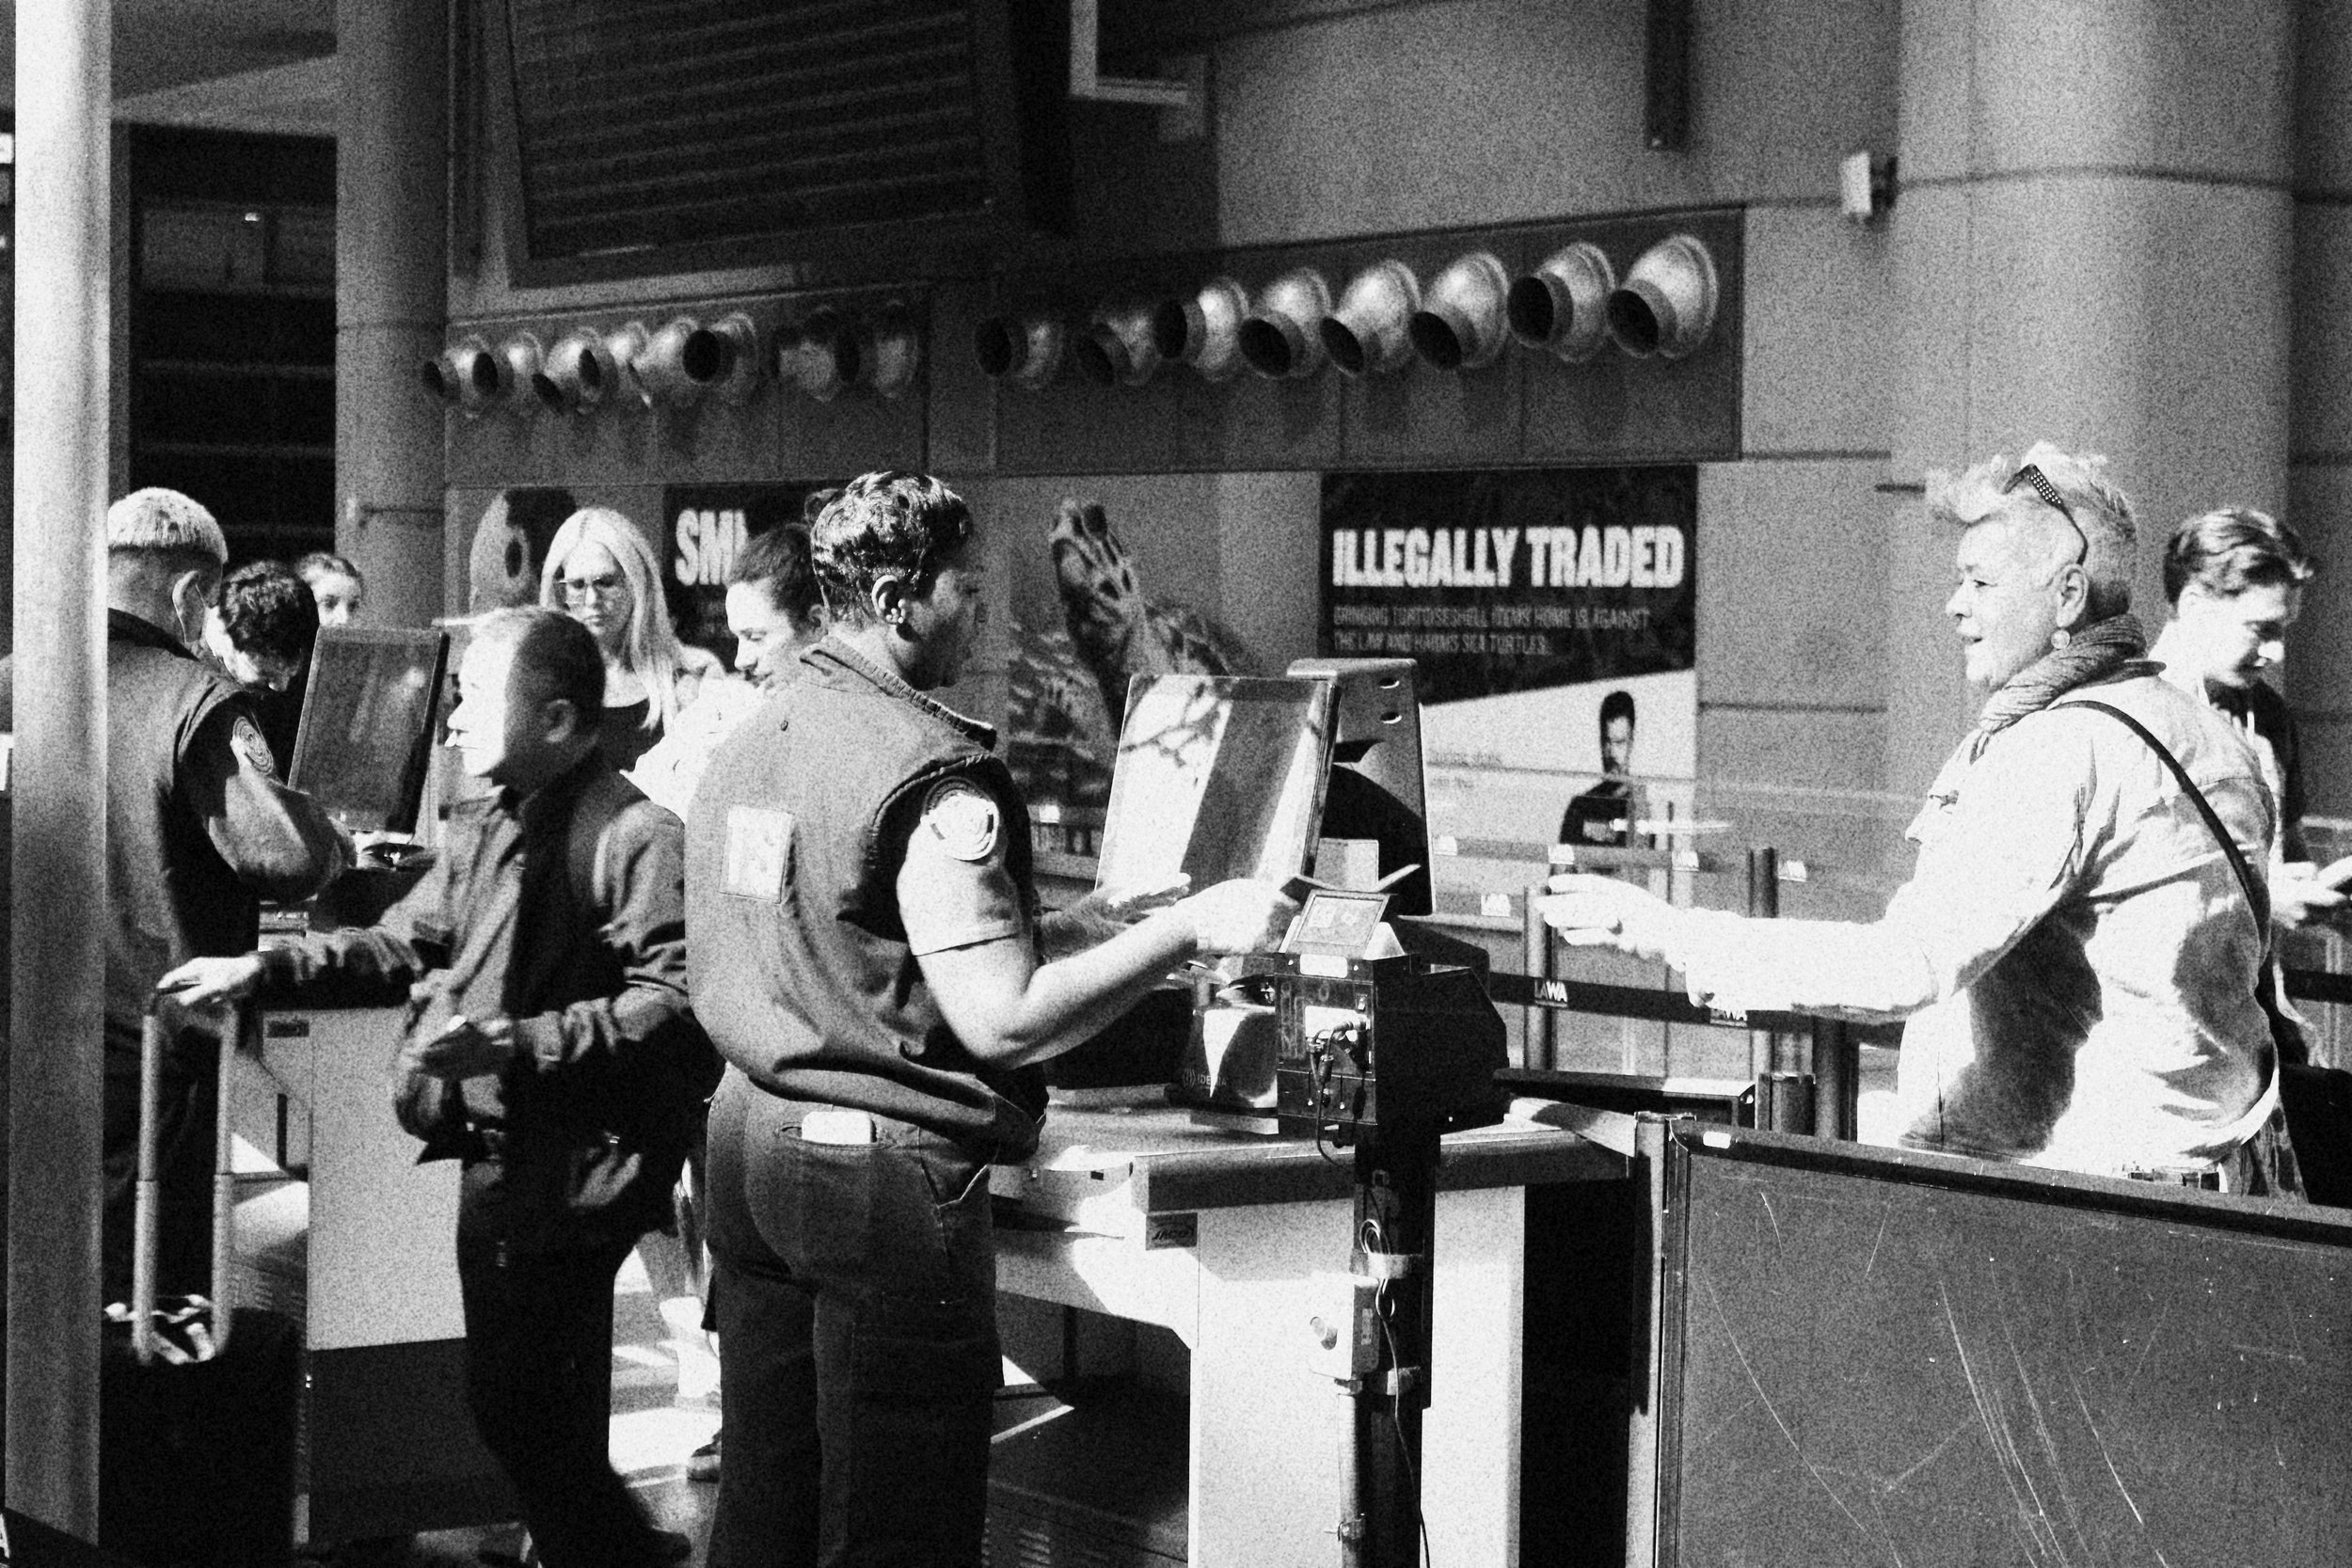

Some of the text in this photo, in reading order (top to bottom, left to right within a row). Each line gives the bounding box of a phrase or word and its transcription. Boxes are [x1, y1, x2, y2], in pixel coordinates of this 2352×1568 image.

[1332, 524, 1685, 588] ILLEGALLY TRADED
[1593, 608, 1650, 629] AGAINST
[1334, 630, 1356, 651] THE
[1534, 979, 1568, 1003] LAWA
